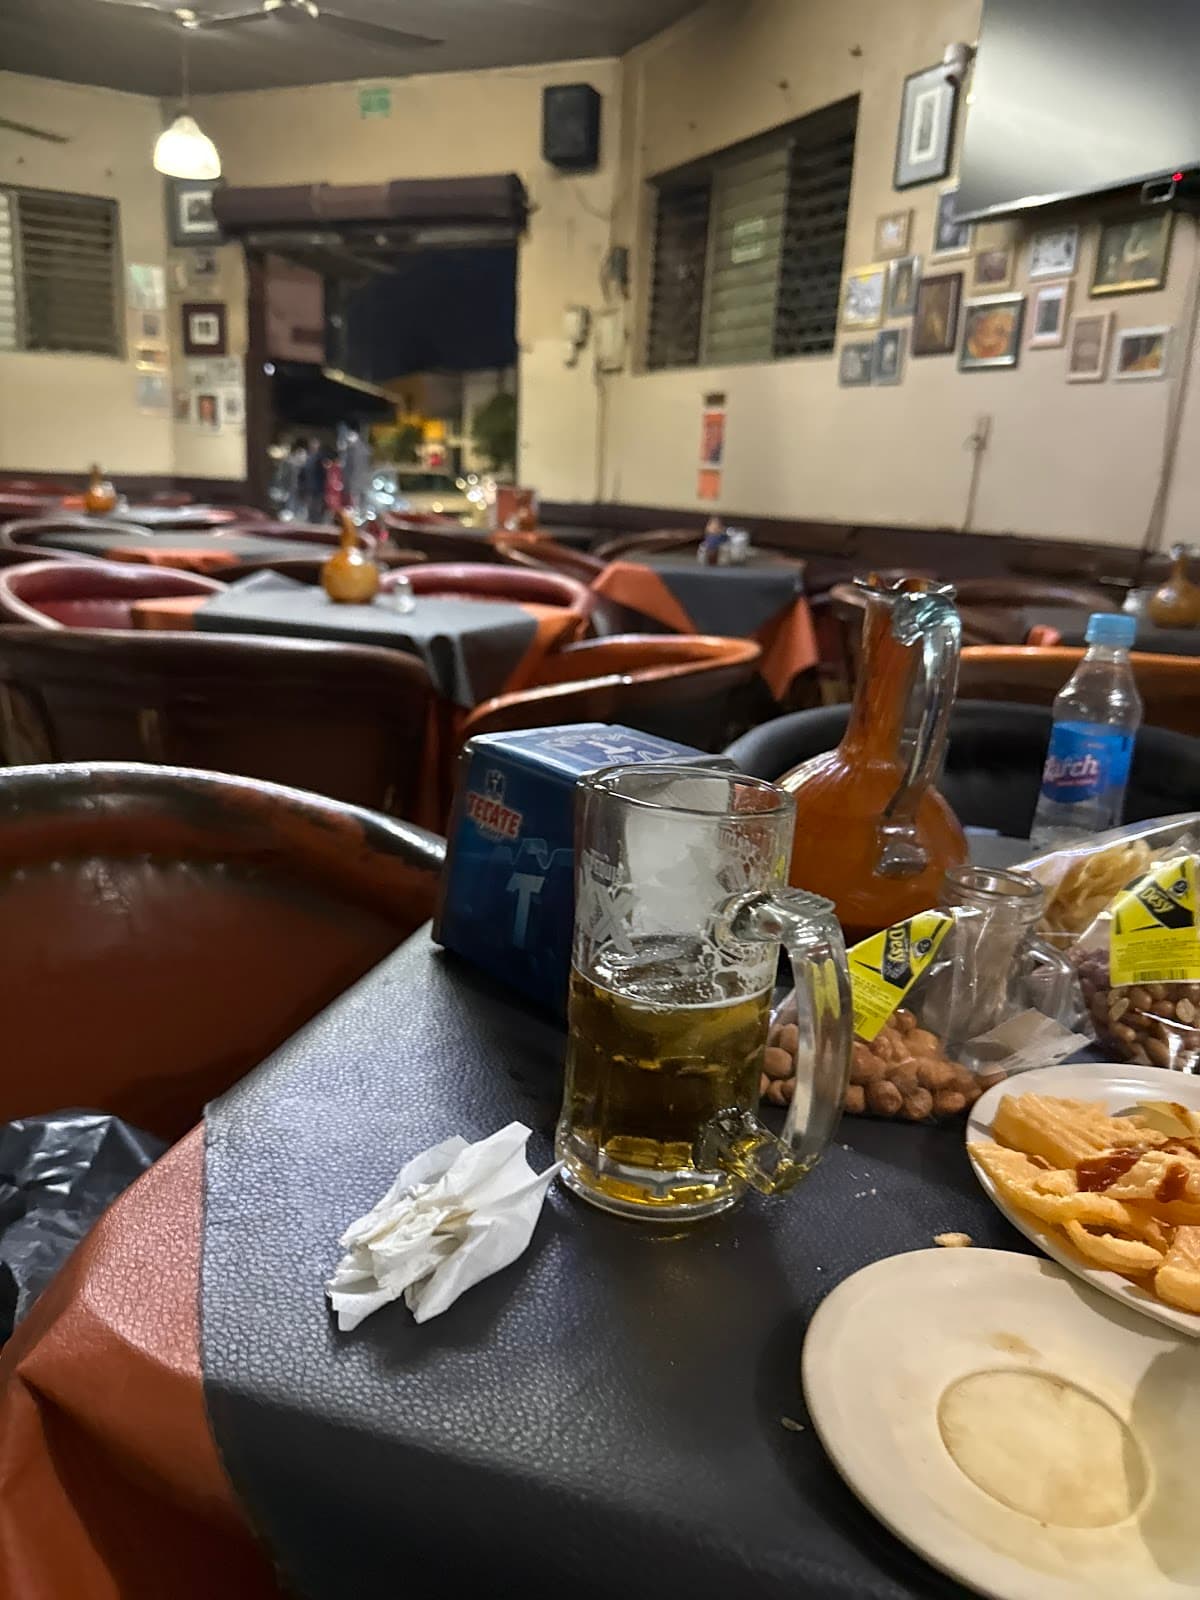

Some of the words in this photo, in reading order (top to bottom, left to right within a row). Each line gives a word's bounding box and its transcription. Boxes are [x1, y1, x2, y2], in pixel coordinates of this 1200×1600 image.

[467, 793, 520, 836] TECATE
[505, 872, 545, 947] T
[1140, 887, 1175, 914] Desy
[887, 928, 906, 963] Desy
